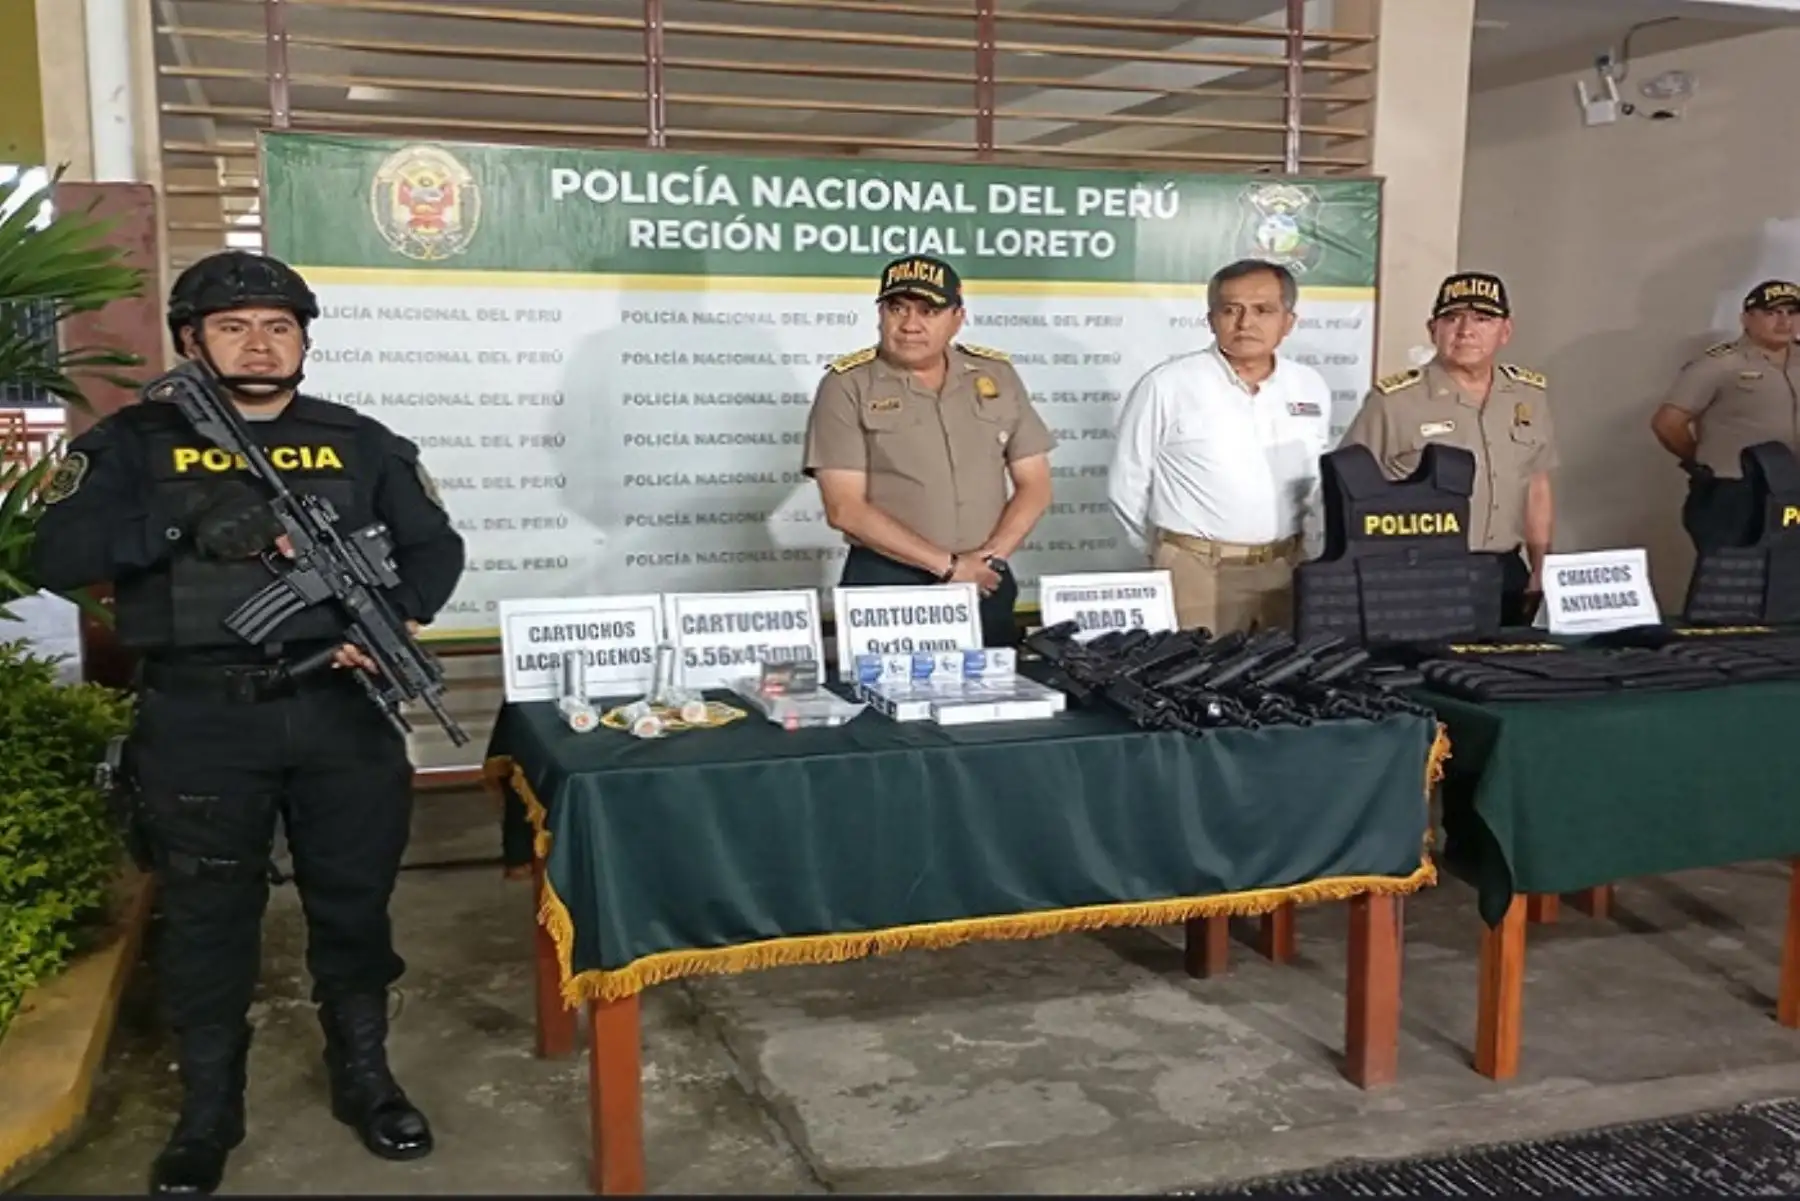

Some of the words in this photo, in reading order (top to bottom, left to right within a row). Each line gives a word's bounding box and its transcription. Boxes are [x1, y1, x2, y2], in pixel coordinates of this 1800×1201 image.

[551, 165, 739, 206] POLICÍA
[752, 175, 977, 213] NACIONAL
[989, 184, 1066, 216] DEL
[1077, 181, 1180, 219] PERÚ
[629, 214, 782, 252] REGIÓN
[793, 223, 967, 255] POLICIAL
[976, 228, 1116, 258] LORETO
[886, 260, 944, 288] POLICIA
[1444, 278, 1499, 303] POLICIA
[323, 305, 372, 320] LICÍA
[377, 307, 471, 321] NACIONAL
[477, 309, 510, 321] DEL
[516, 307, 562, 323] PERÚ
[621, 310, 689, 325] POLICÍA
[693, 312, 776, 325] NACIONAL
[780, 313, 811, 325] DEL
[816, 310, 858, 326] PERÚ
[974, 315, 1048, 327] NACIONAL
[1053, 316, 1080, 327] DEL
[312, 347, 373, 363] OLICÍA
[379, 350, 472, 363] NACIONAL
[478, 351, 511, 363] DEL
[516, 348, 563, 364] PERÚ
[622, 350, 689, 365] POLICÍA
[693, 353, 776, 365] NACIONAL
[781, 353, 811, 365] DEL
[1053, 353, 1079, 365] DEL
[317, 389, 376, 406] LICÍA
[381, 393, 475, 406] NACIONAL
[480, 394, 514, 406] DEL
[518, 391, 565, 406] PERÚ
[623, 390, 690, 406] POLICÍA
[693, 392, 777, 406] NACIONAL
[781, 392, 811, 405] DEL
[412, 434, 476, 448] IONAL
[480, 435, 513, 447] DEL
[520, 432, 566, 448] PERÚ
[624, 432, 690, 447] POLICÍA
[694, 433, 777, 446] NACIONAL
[781, 432, 804, 446] DE
[173, 445, 344, 473] POCIA
[482, 476, 515, 489] DEL
[521, 473, 567, 489] PERÚ
[623, 471, 691, 487] POLICÍA
[696, 472, 777, 486] NACIONAL
[1081, 503, 1112, 514] PER
[484, 518, 516, 530] DEL
[521, 514, 569, 530] PERÚ
[625, 511, 692, 527] POLICÍA
[1364, 512, 1460, 536] POLICIA
[484, 558, 517, 571] DEL
[523, 556, 568, 570] PERÚ
[626, 551, 692, 567] POLICÍA
[697, 550, 778, 565] NACIONAL
[816, 547, 847, 560] PER
[682, 609, 809, 635] CARTUCHOS
[850, 603, 969, 628] CARTUCHOS
[1130, 607, 1144, 629] 5
[528, 621, 636, 643] CARTUCHOS
[516, 646, 653, 672] LACRGENOS
[683, 643, 813, 668] 5.56x45mm
